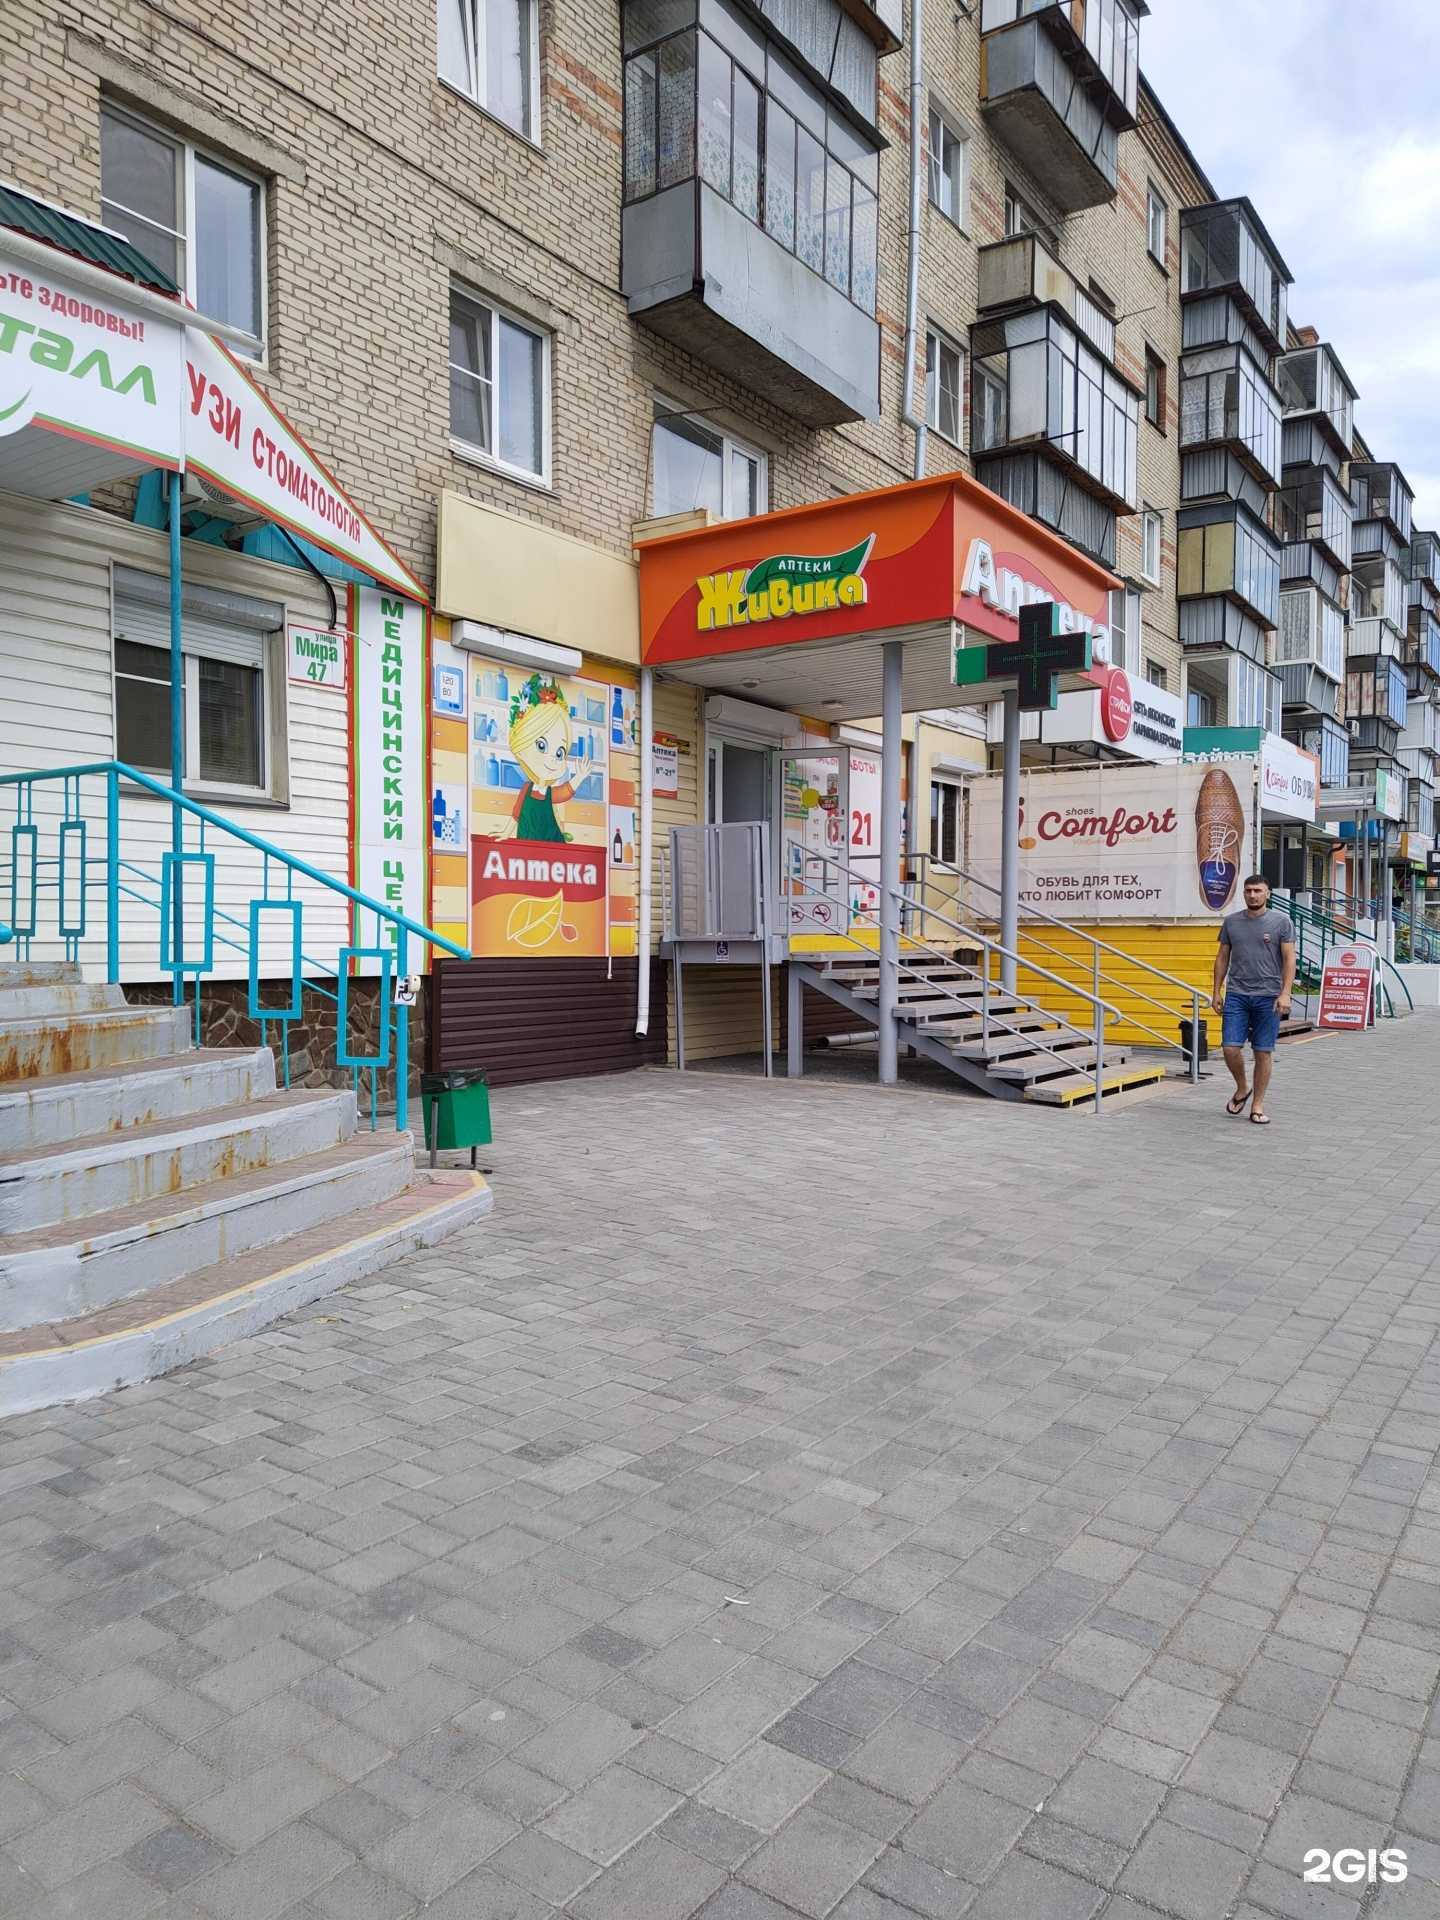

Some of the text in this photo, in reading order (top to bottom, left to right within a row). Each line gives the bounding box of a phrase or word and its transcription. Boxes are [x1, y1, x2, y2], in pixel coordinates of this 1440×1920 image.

[38, 286, 145, 342] здоровы!
[186, 360, 362, 545] УЗИ СТОМАТОЛОГИЯ
[778, 560, 832, 574] АПТЕКИ
[696, 568, 867, 632] Живика
[295, 636, 338, 663] Мира
[307, 661, 327, 682] 47
[380, 597, 405, 841] МЕДИЦИНСКИЙ
[851, 810, 872, 847] 21
[1037, 808, 1178, 847] Comfort
[1065, 807, 1095, 816] shoes
[482, 850, 597, 885] Аптека
[1036, 874, 1142, 888] ОБУВЬ ДЛЯ ТЕХ,
[1018, 888, 1162, 902] КТО ЛЮБИТ КОМФОРТ
